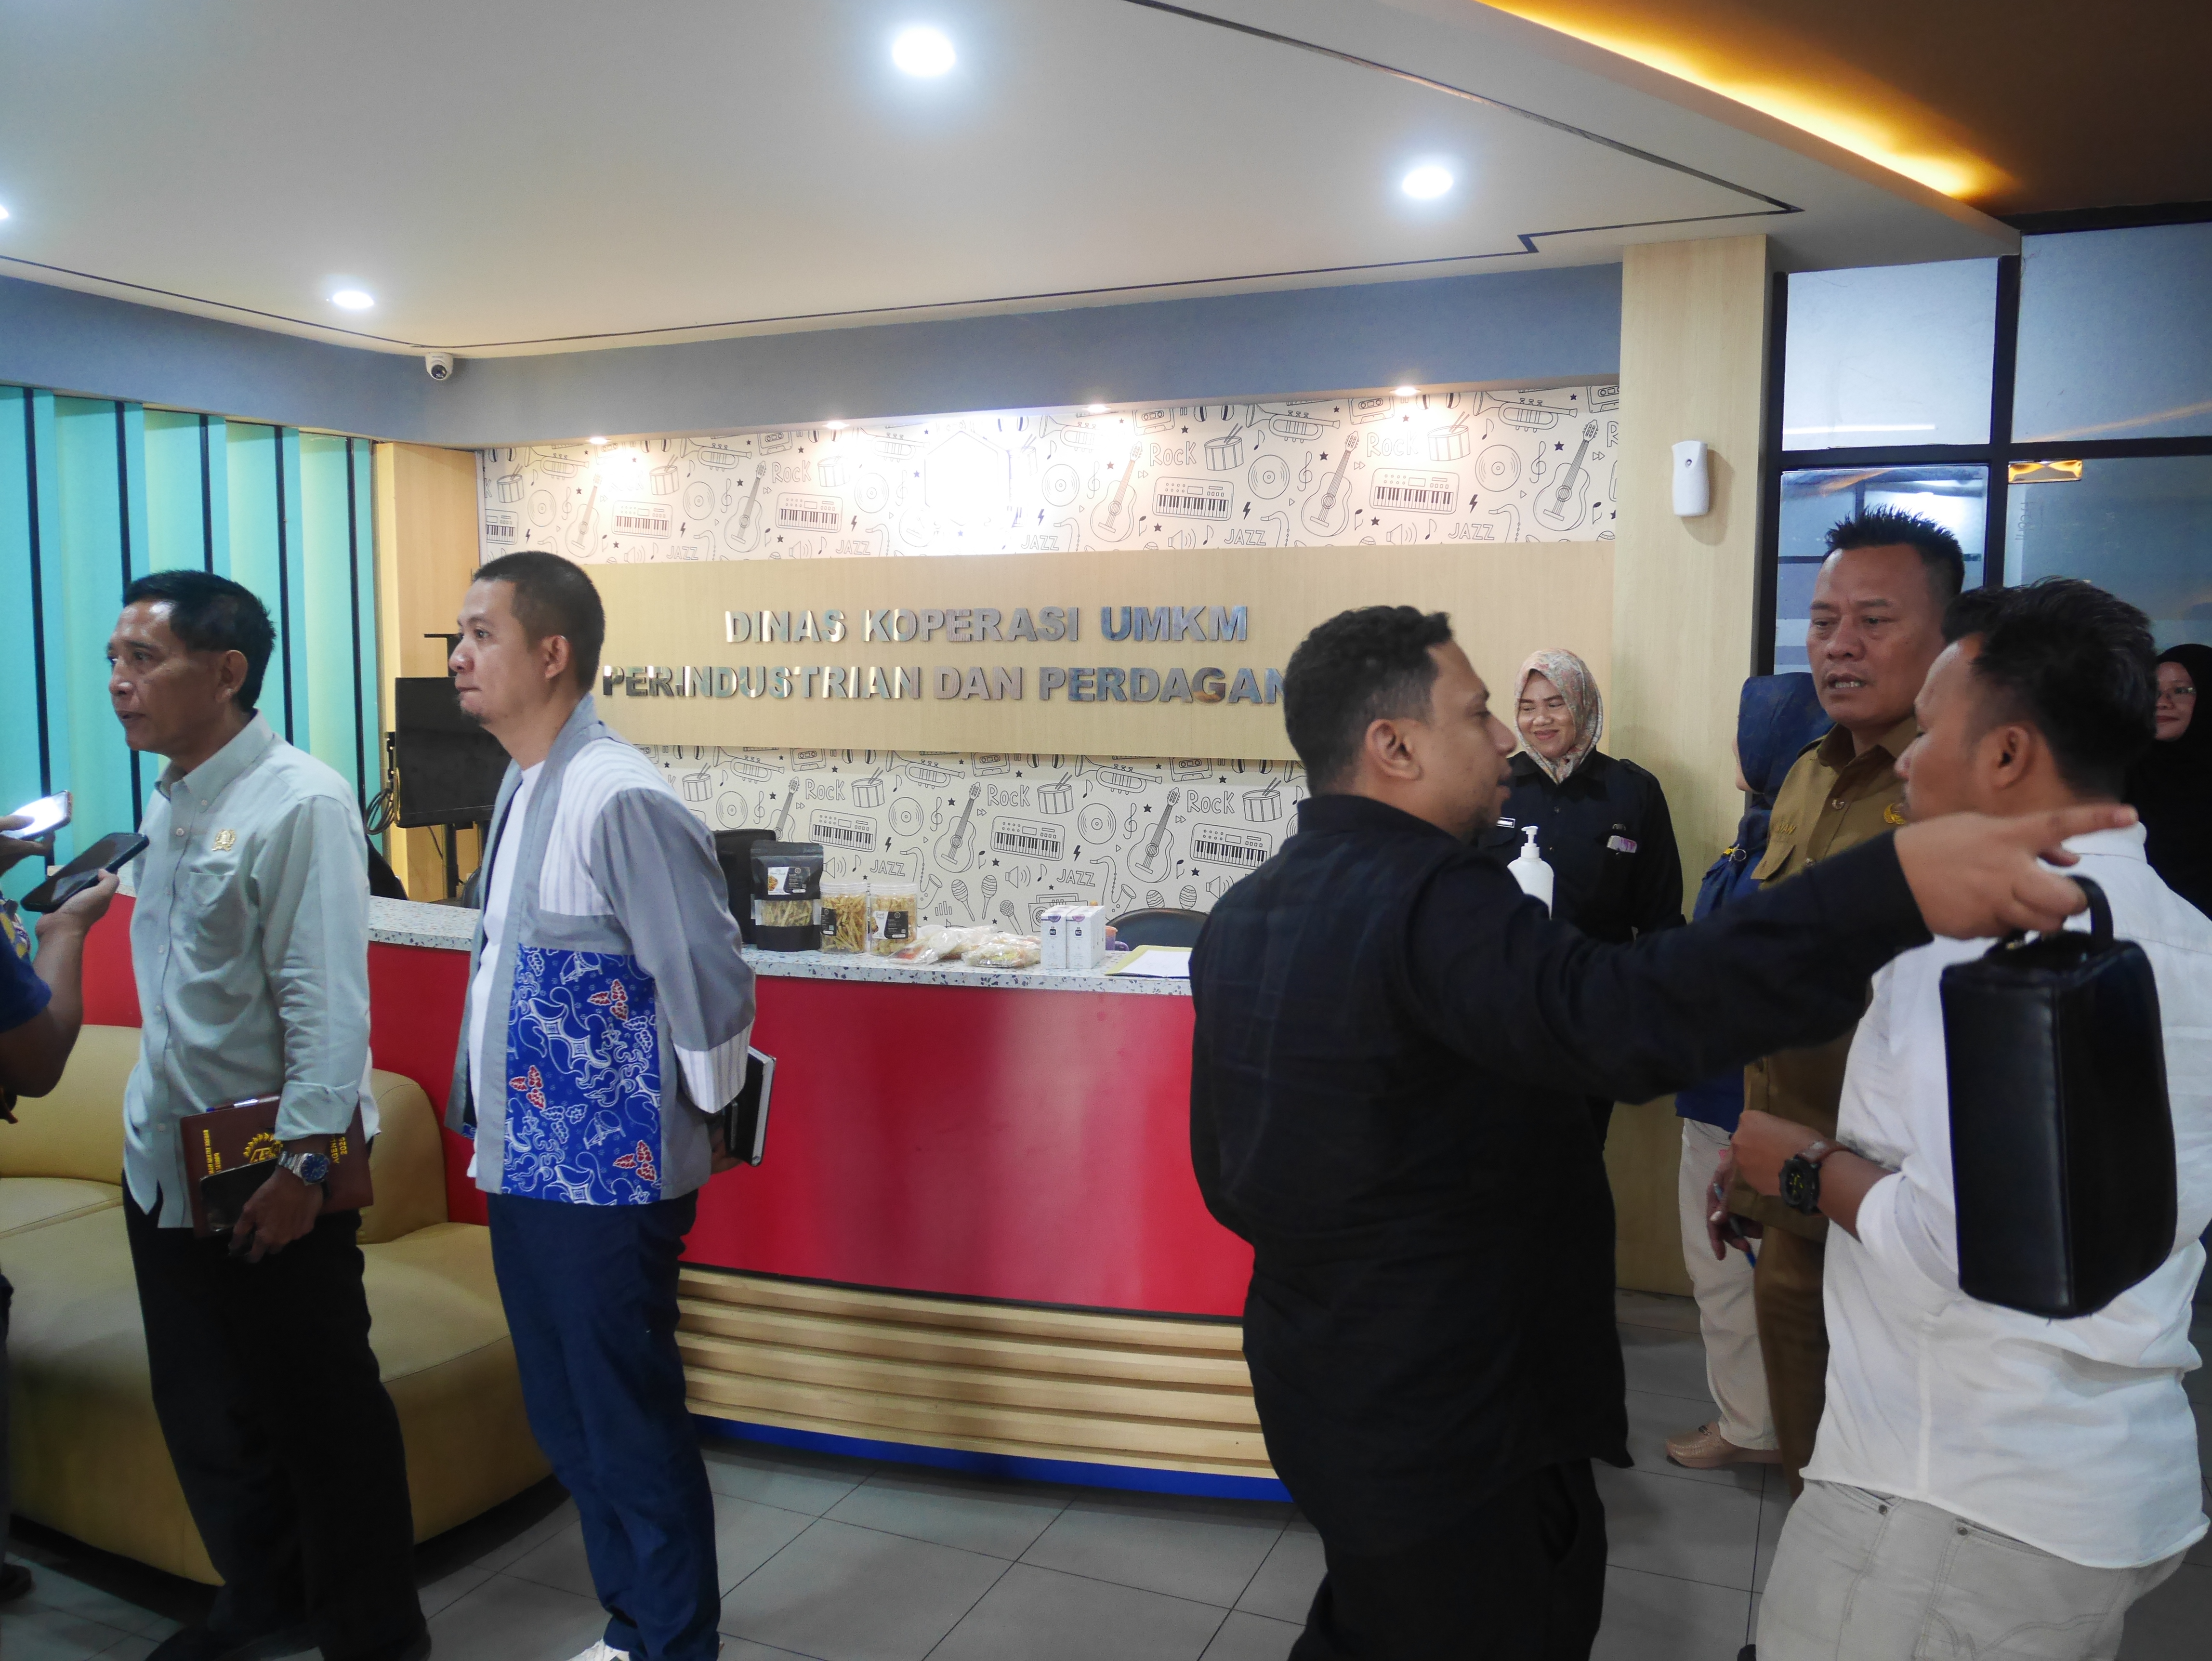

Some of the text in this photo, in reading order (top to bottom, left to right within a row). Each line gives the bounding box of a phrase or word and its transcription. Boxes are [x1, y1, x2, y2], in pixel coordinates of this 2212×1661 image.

[1150, 441, 1197, 466] ROCK
[772, 460, 811, 483] ROCK
[1224, 529, 1266, 546] JAZZ
[1448, 523, 1495, 540] JAZZ
[667, 546, 698, 560] JAZZ
[835, 540, 871, 555] JAZZ
[1020, 535, 1059, 551] JAZZ
[725, 606, 1248, 643] DINAS KOPERASI UMKM
[603, 665, 921, 699] PERINDUSTRIAN
[933, 666, 1022, 700] DAN
[805, 779, 845, 801] ROCK
[988, 785, 1030, 807] ROCK
[1187, 790, 1235, 814] ROCK
[869, 859, 906, 876] JAZZ
[1056, 869, 1096, 887] JAZZ
